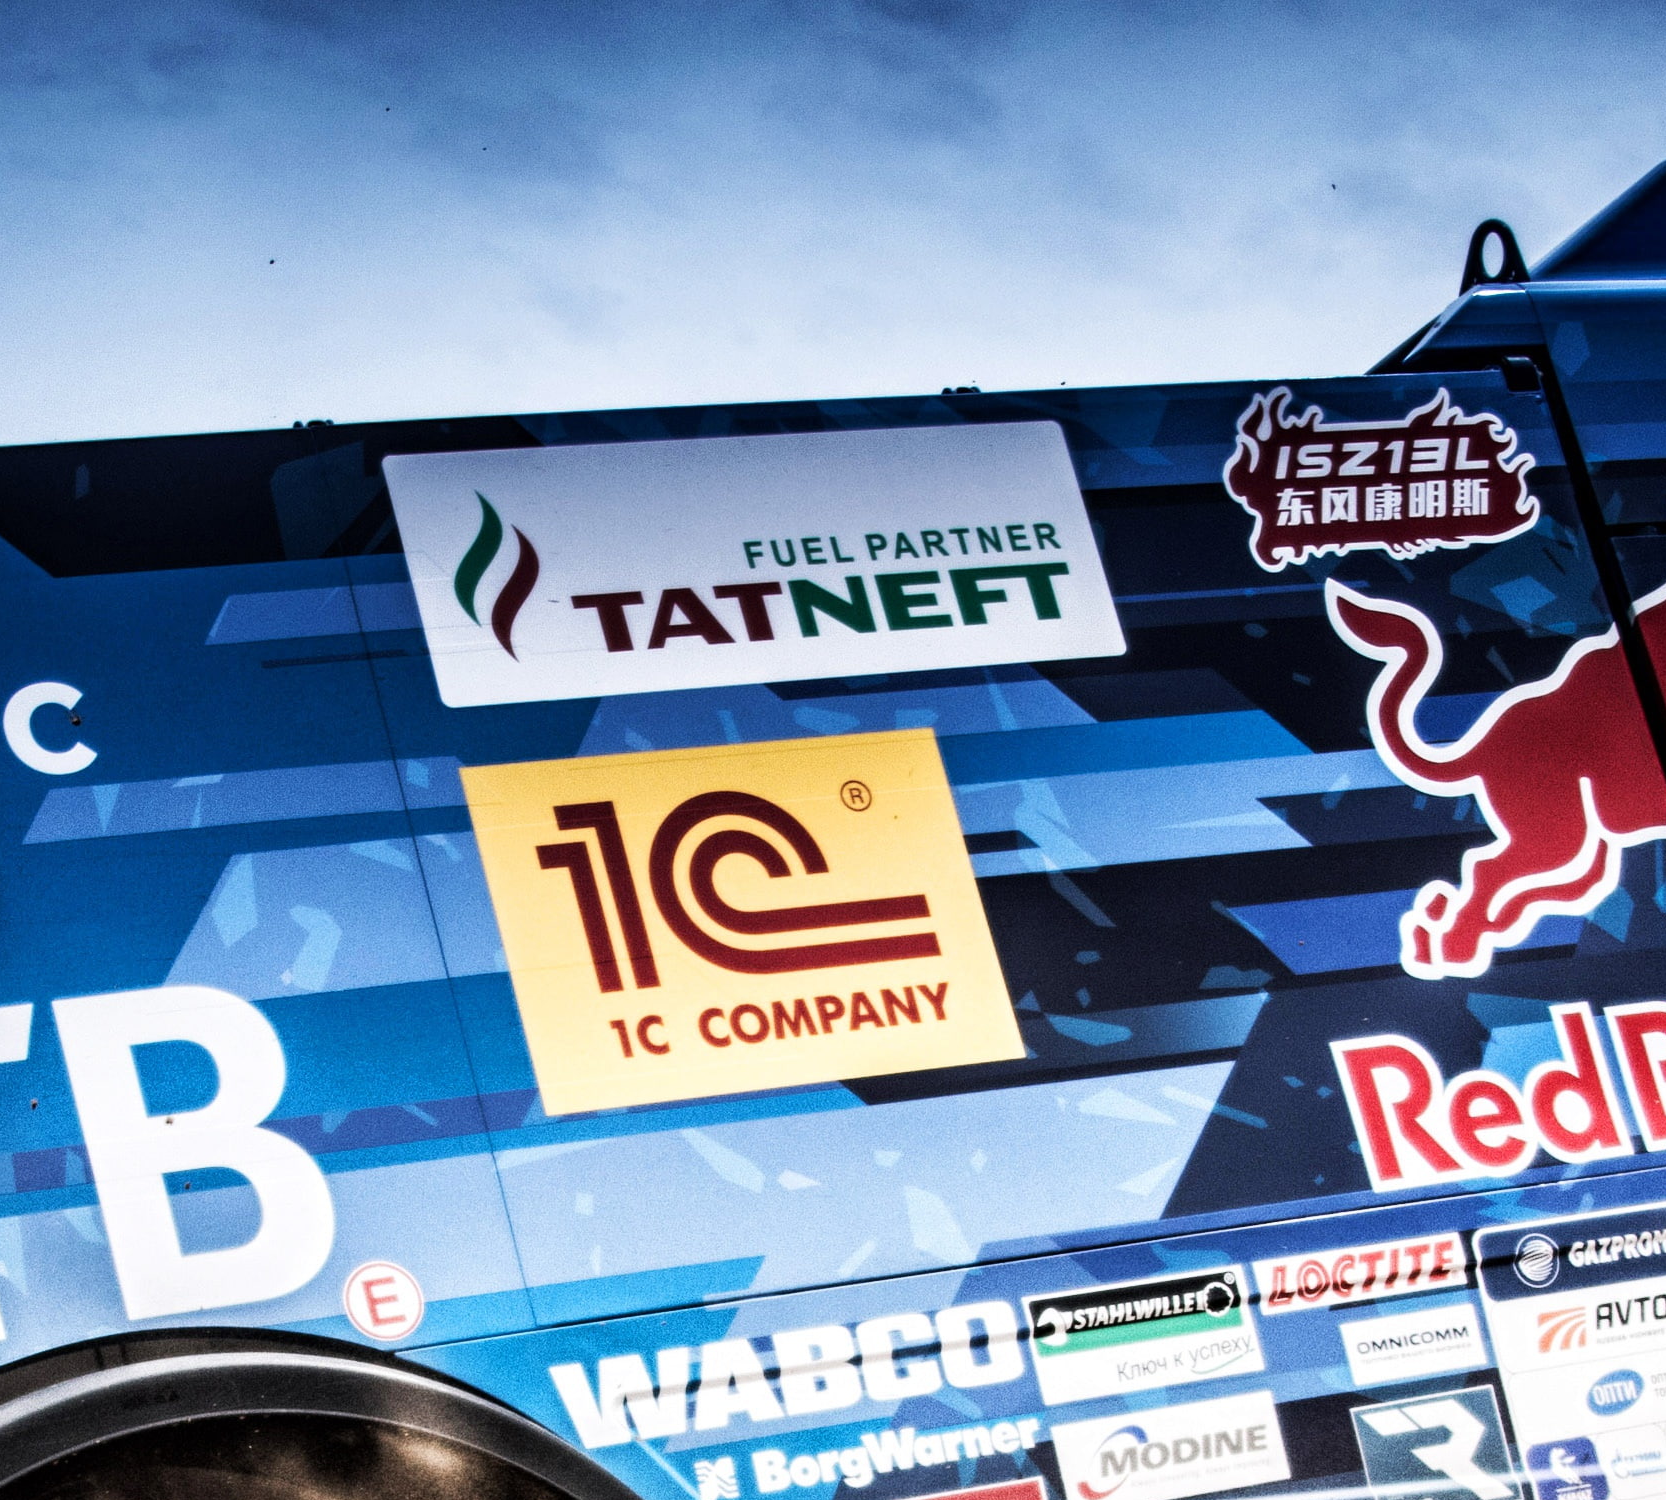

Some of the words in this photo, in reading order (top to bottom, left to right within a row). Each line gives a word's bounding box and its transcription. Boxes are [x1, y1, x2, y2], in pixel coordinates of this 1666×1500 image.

[1276, 478, 1489, 527] 东风康明斯
[743, 531, 854, 569] FUEL
[866, 521, 1063, 562] PARTNER
[571, 562, 1070, 653] TATNEFT
[697, 982, 950, 1050] COMPANY
[1267, 1239, 1455, 1308] LOCTITE
[361, 1275, 407, 1327] E
[1074, 1291, 1196, 1331] STAHLWILLE
[1117, 1358, 1169, 1383] Ключ
[1189, 1335, 1252, 1363] успеху
[1356, 1325, 1470, 1355] OMNICOMM
[549, 1299, 1026, 1450] WABCO
[1099, 1423, 1268, 1479] MODINE
